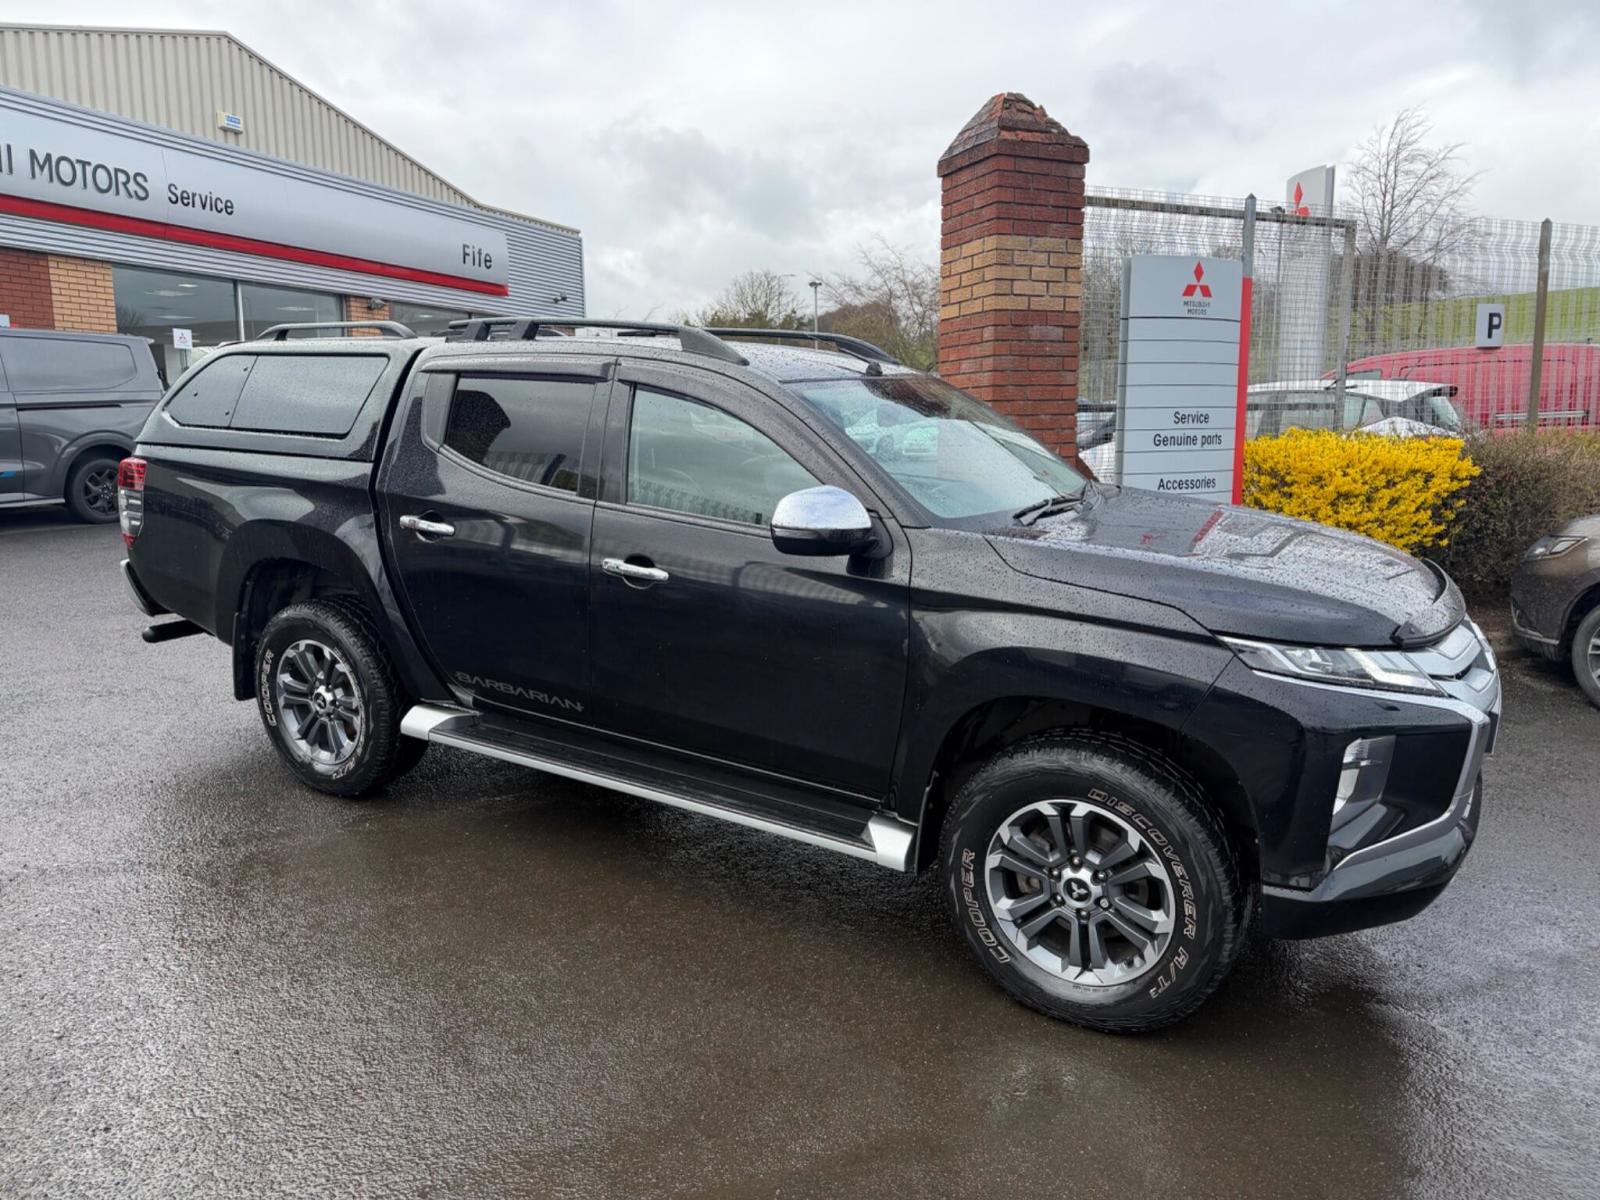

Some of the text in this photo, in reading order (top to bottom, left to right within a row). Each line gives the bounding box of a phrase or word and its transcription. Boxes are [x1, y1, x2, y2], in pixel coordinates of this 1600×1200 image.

[29, 148, 150, 201] MOTORS
[168, 183, 234, 216] Service
[462, 243, 492, 270] Fife
[1487, 312, 1502, 339] P
[1173, 411, 1210, 425] Service
[1153, 433, 1222, 448] Genuine parts
[1157, 475, 1216, 491] Accessories
[455, 671, 584, 712] BARBARIAN
[1088, 788, 1197, 940] DISCOVERER
[961, 847, 1011, 964] COOPER
